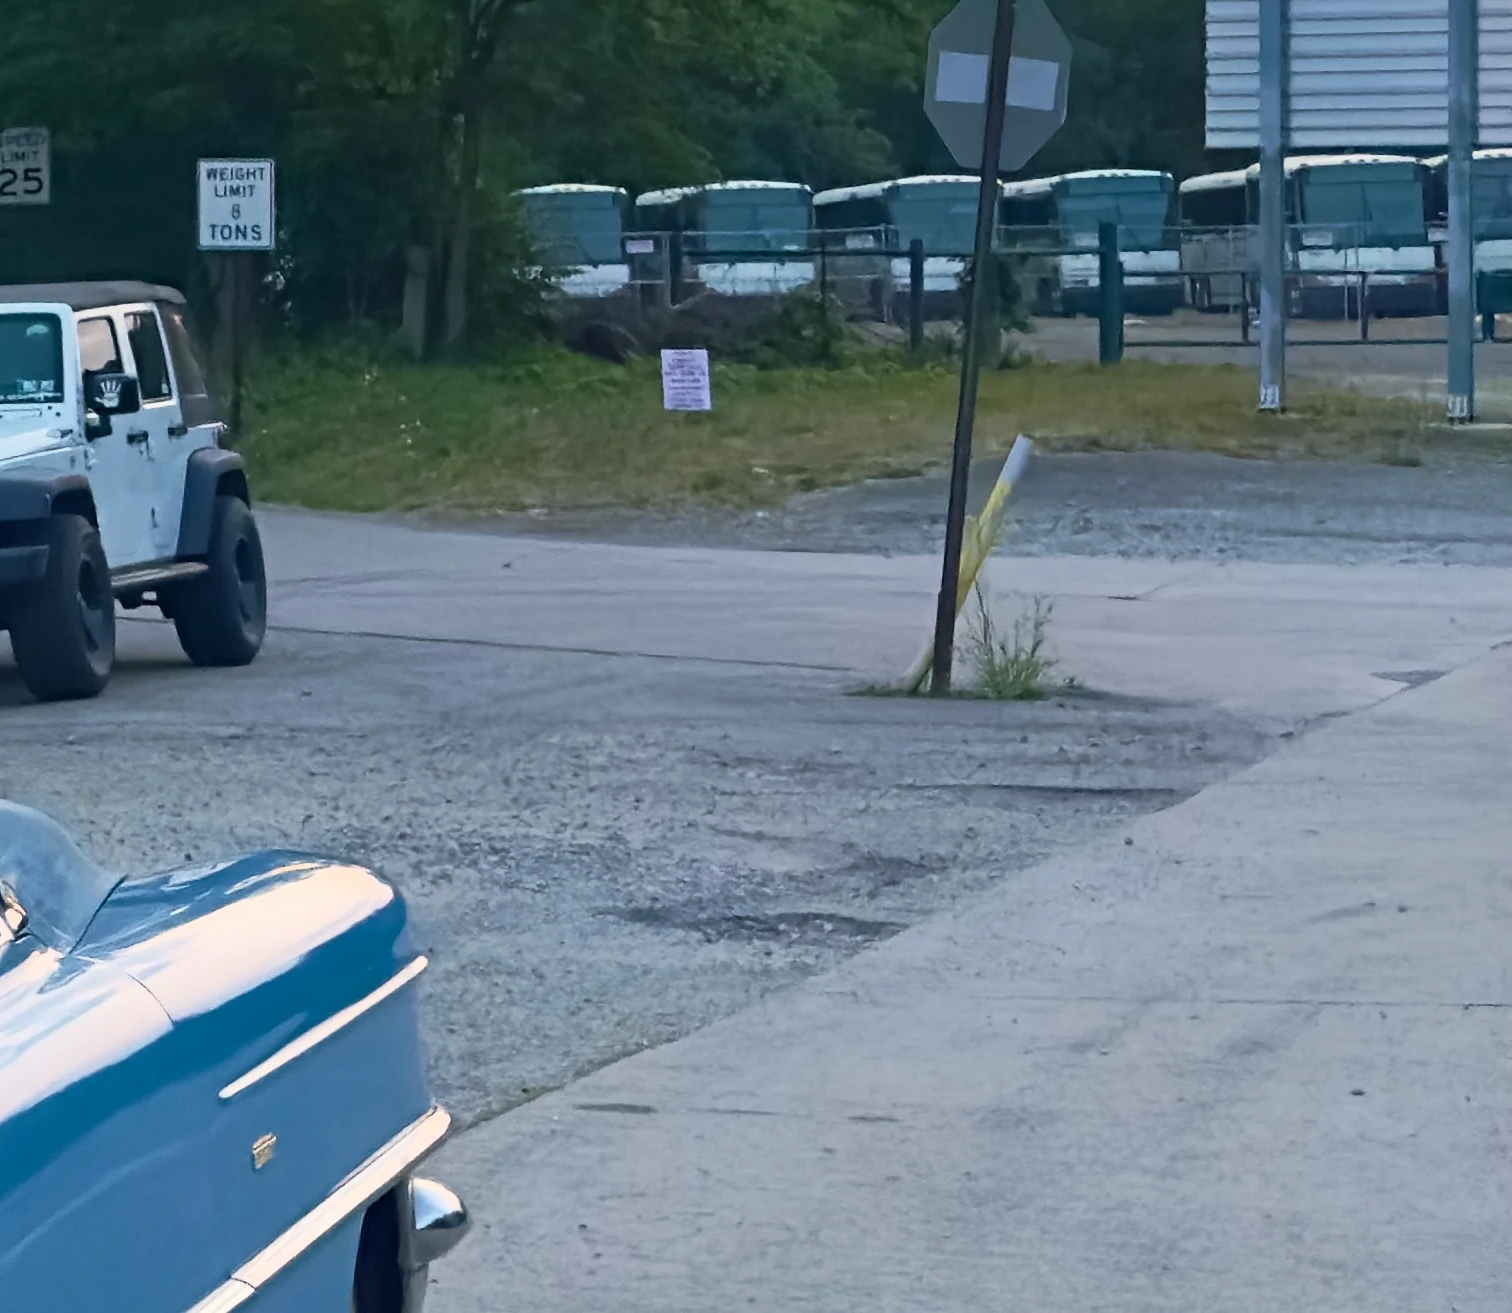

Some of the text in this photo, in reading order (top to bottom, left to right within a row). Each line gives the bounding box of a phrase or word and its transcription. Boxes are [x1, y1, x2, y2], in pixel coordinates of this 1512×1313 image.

[1, 150, 41, 163] LIMIT
[206, 166, 266, 182] WEIGHT
[214, 184, 256, 199] LIMIT
[230, 204, 242, 221] 8
[209, 224, 263, 242] TONS
